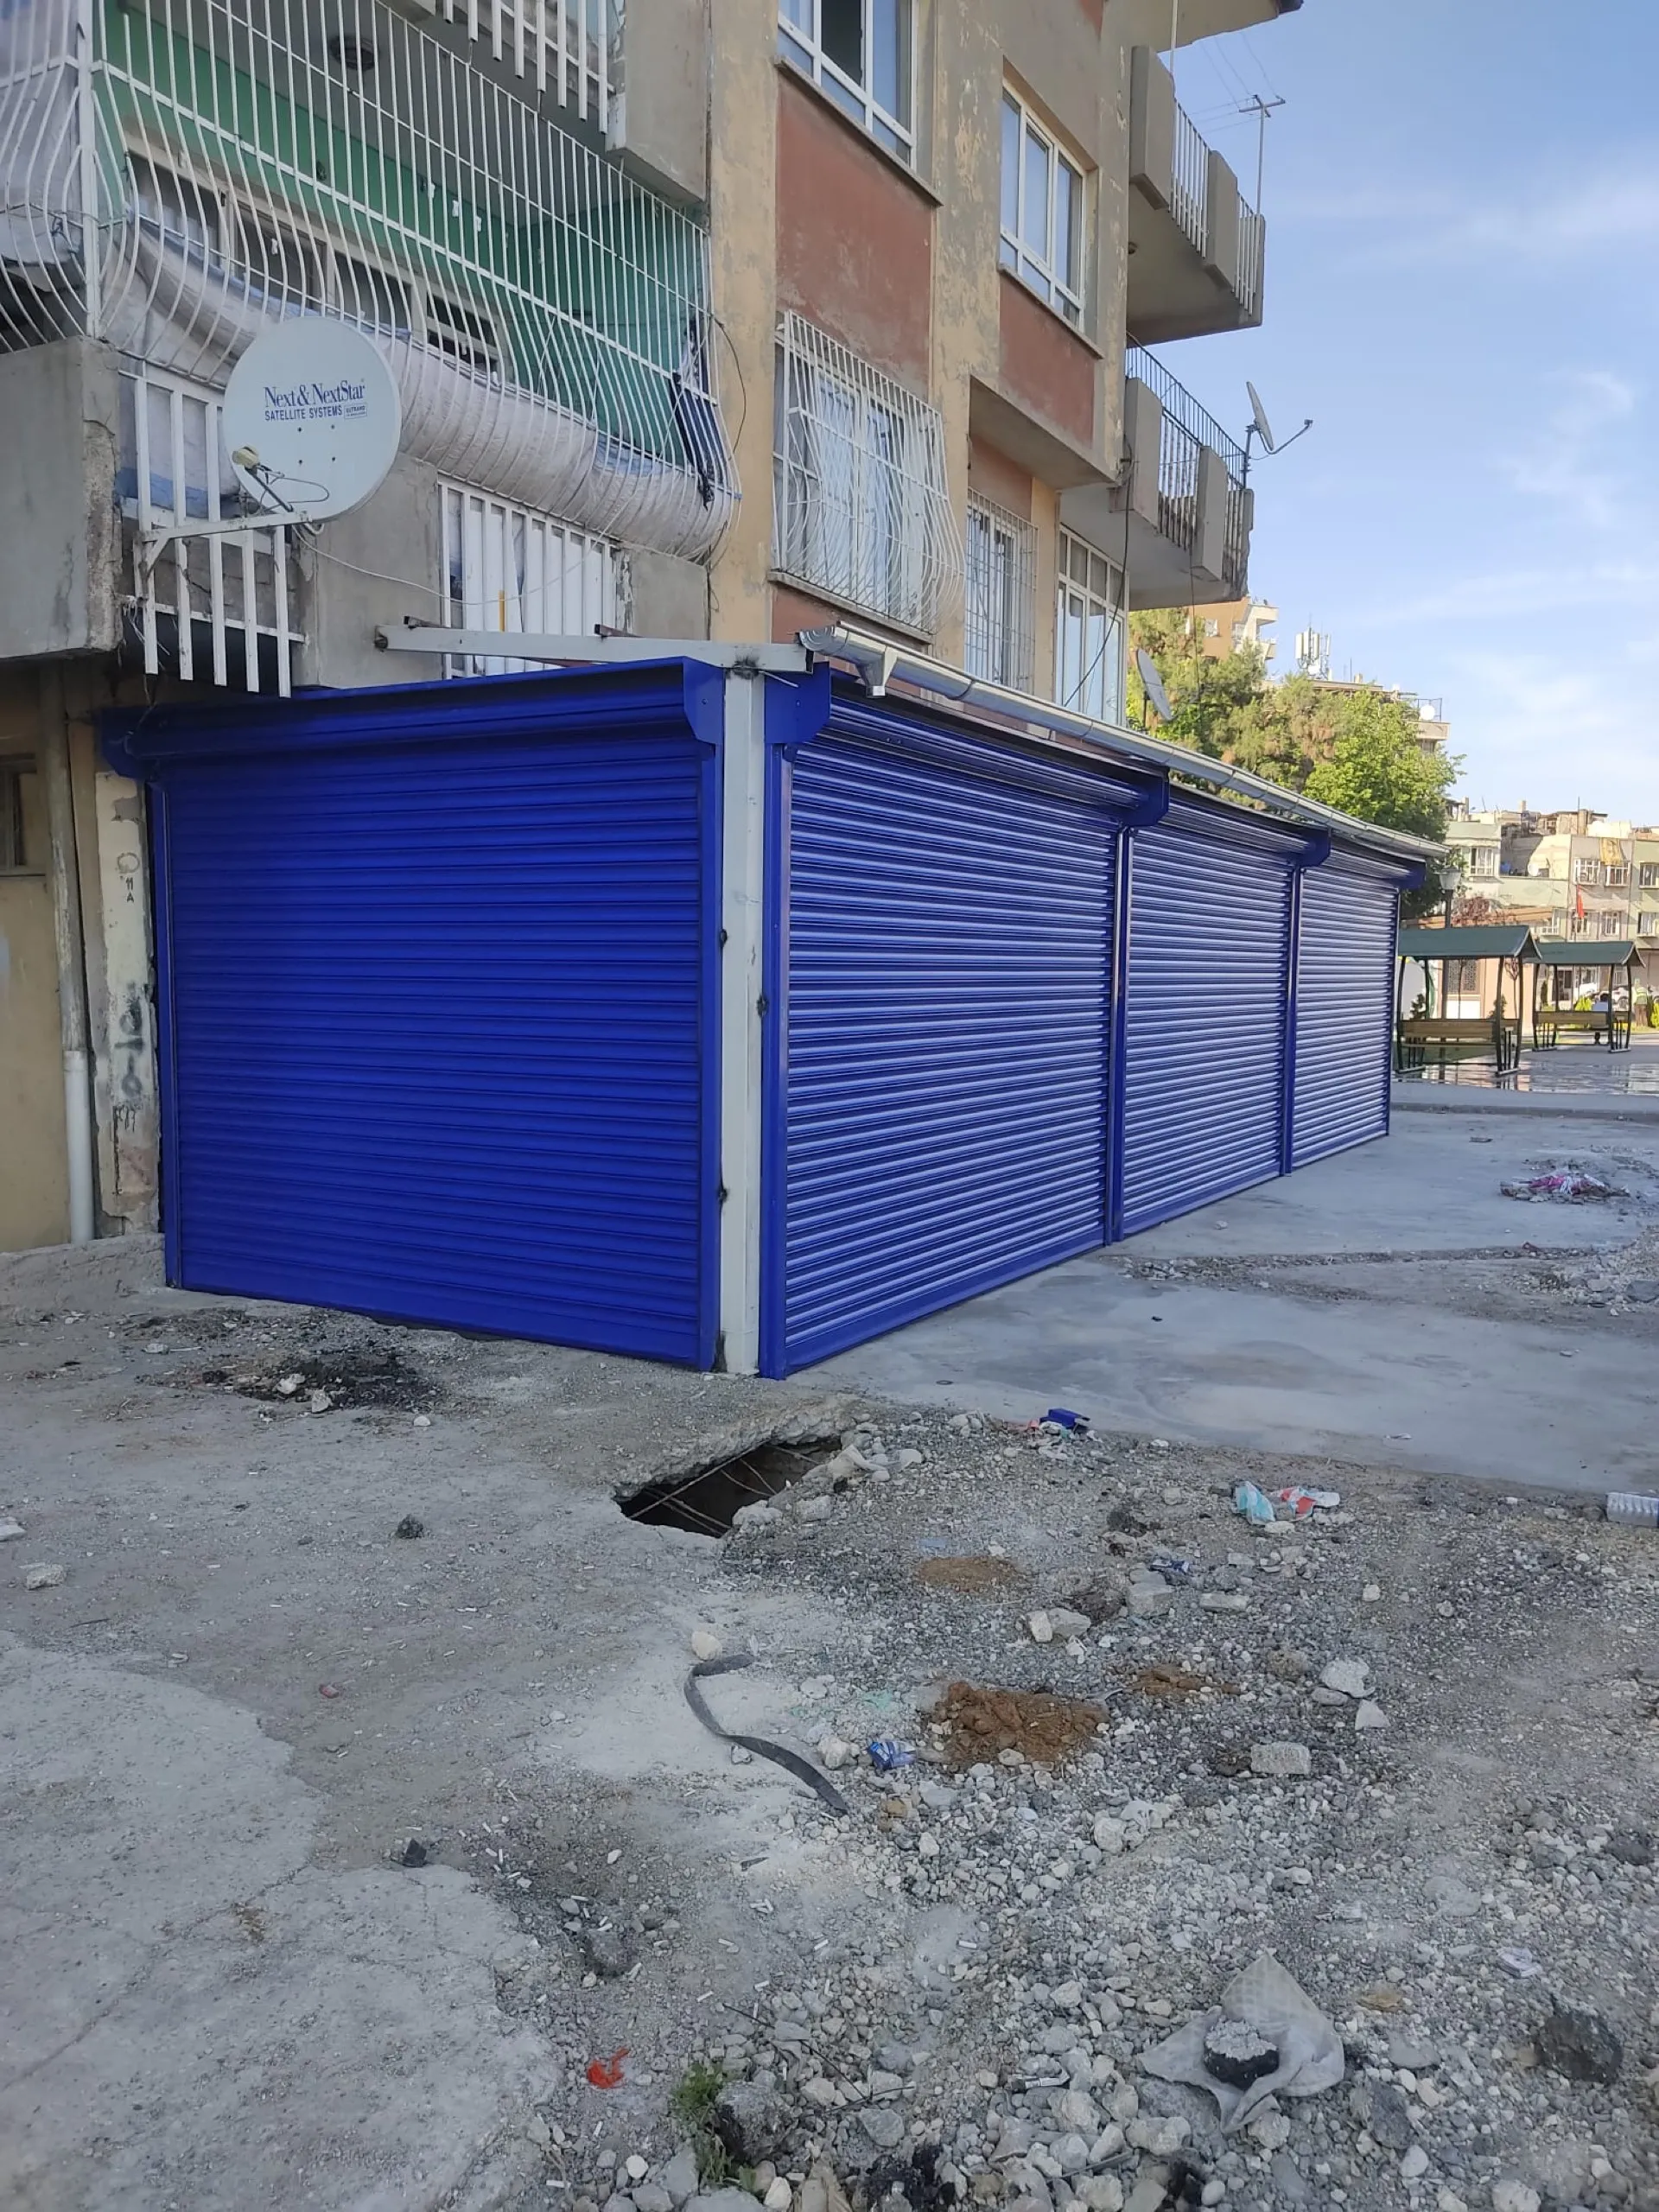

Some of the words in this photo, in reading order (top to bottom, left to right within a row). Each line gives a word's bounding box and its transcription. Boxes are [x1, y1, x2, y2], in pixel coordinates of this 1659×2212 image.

[263, 386, 296, 408] Next
[296, 385, 310, 407] &
[311, 379, 365, 405] NextStar
[264, 409, 306, 421] SATELLITE
[308, 404, 342, 419] SYSTEMS
[125, 877, 134, 891] 11
[126, 892, 135, 903] A
